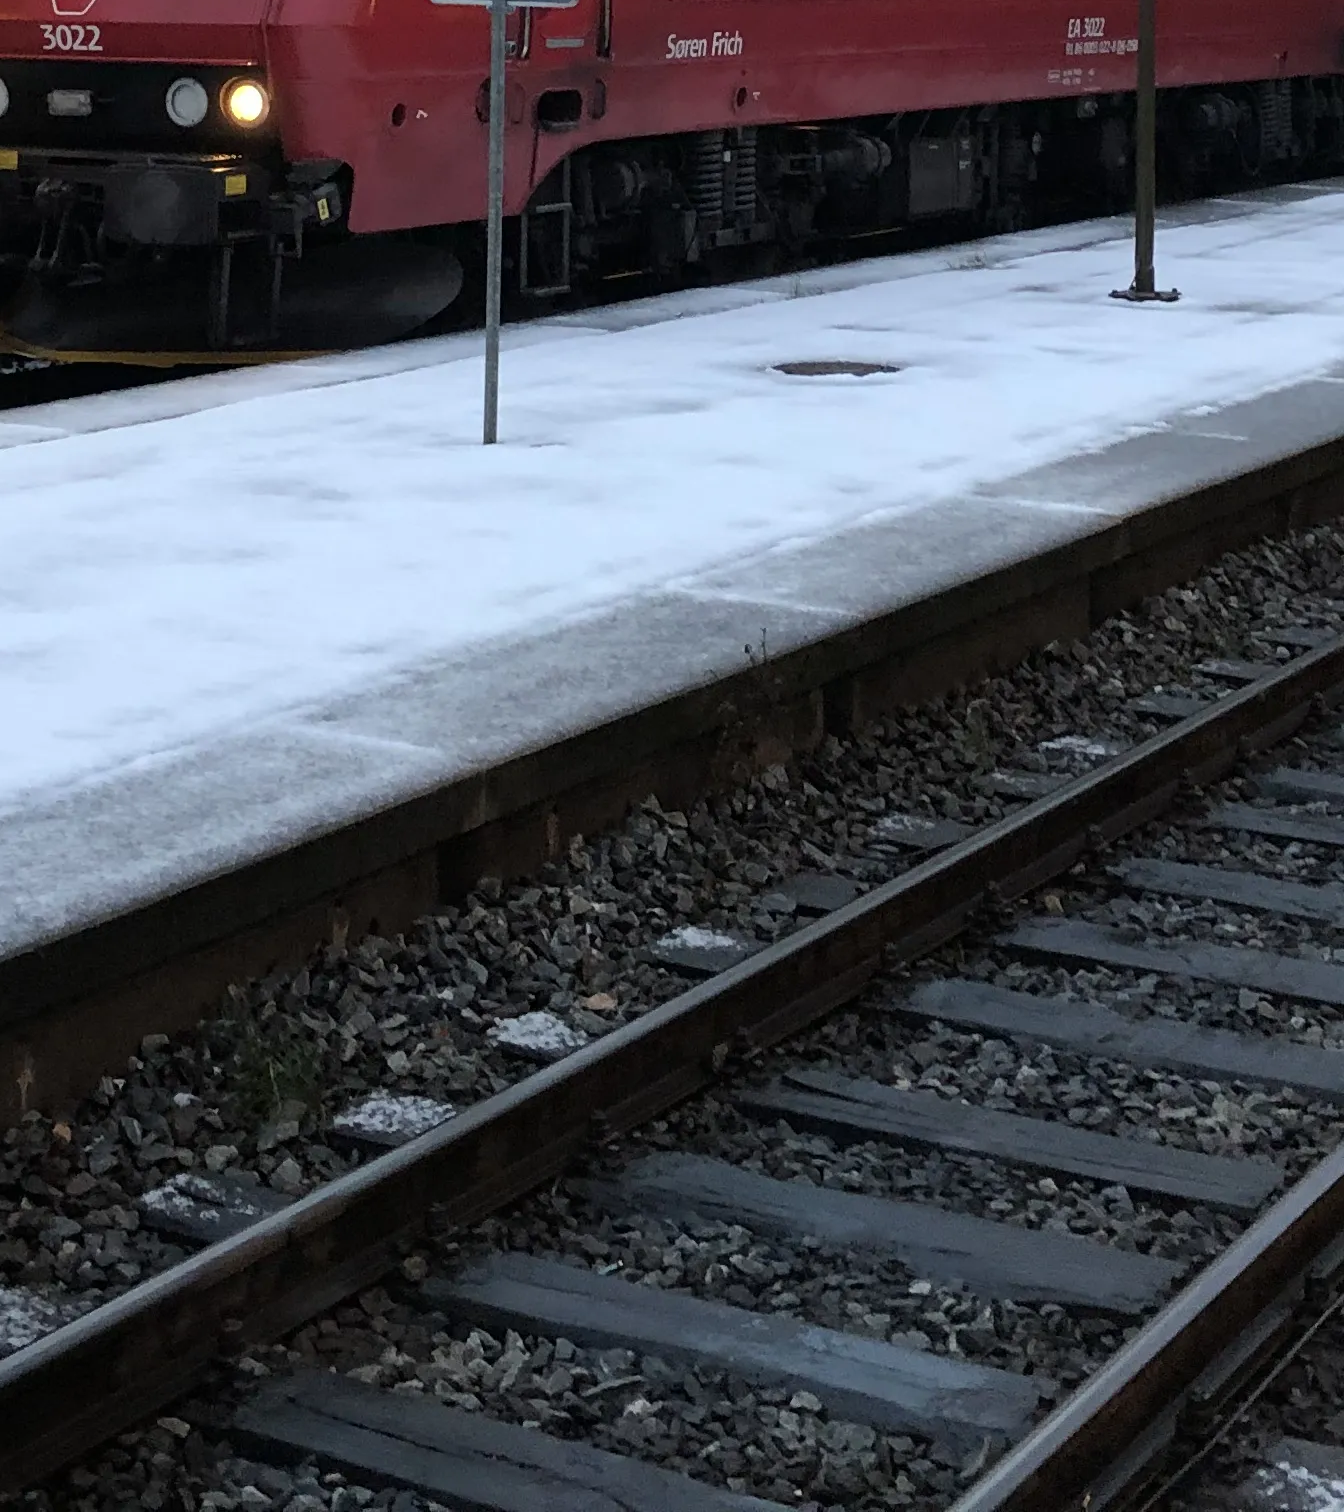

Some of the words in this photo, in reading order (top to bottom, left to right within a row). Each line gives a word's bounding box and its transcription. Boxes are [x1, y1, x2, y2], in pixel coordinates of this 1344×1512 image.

[40, 24, 104, 51] 3022
[1067, 18, 1081, 39] EA
[1082, 17, 1105, 37] 3022
[666, 33, 707, 59] Søren
[711, 30, 743, 56] Frich
